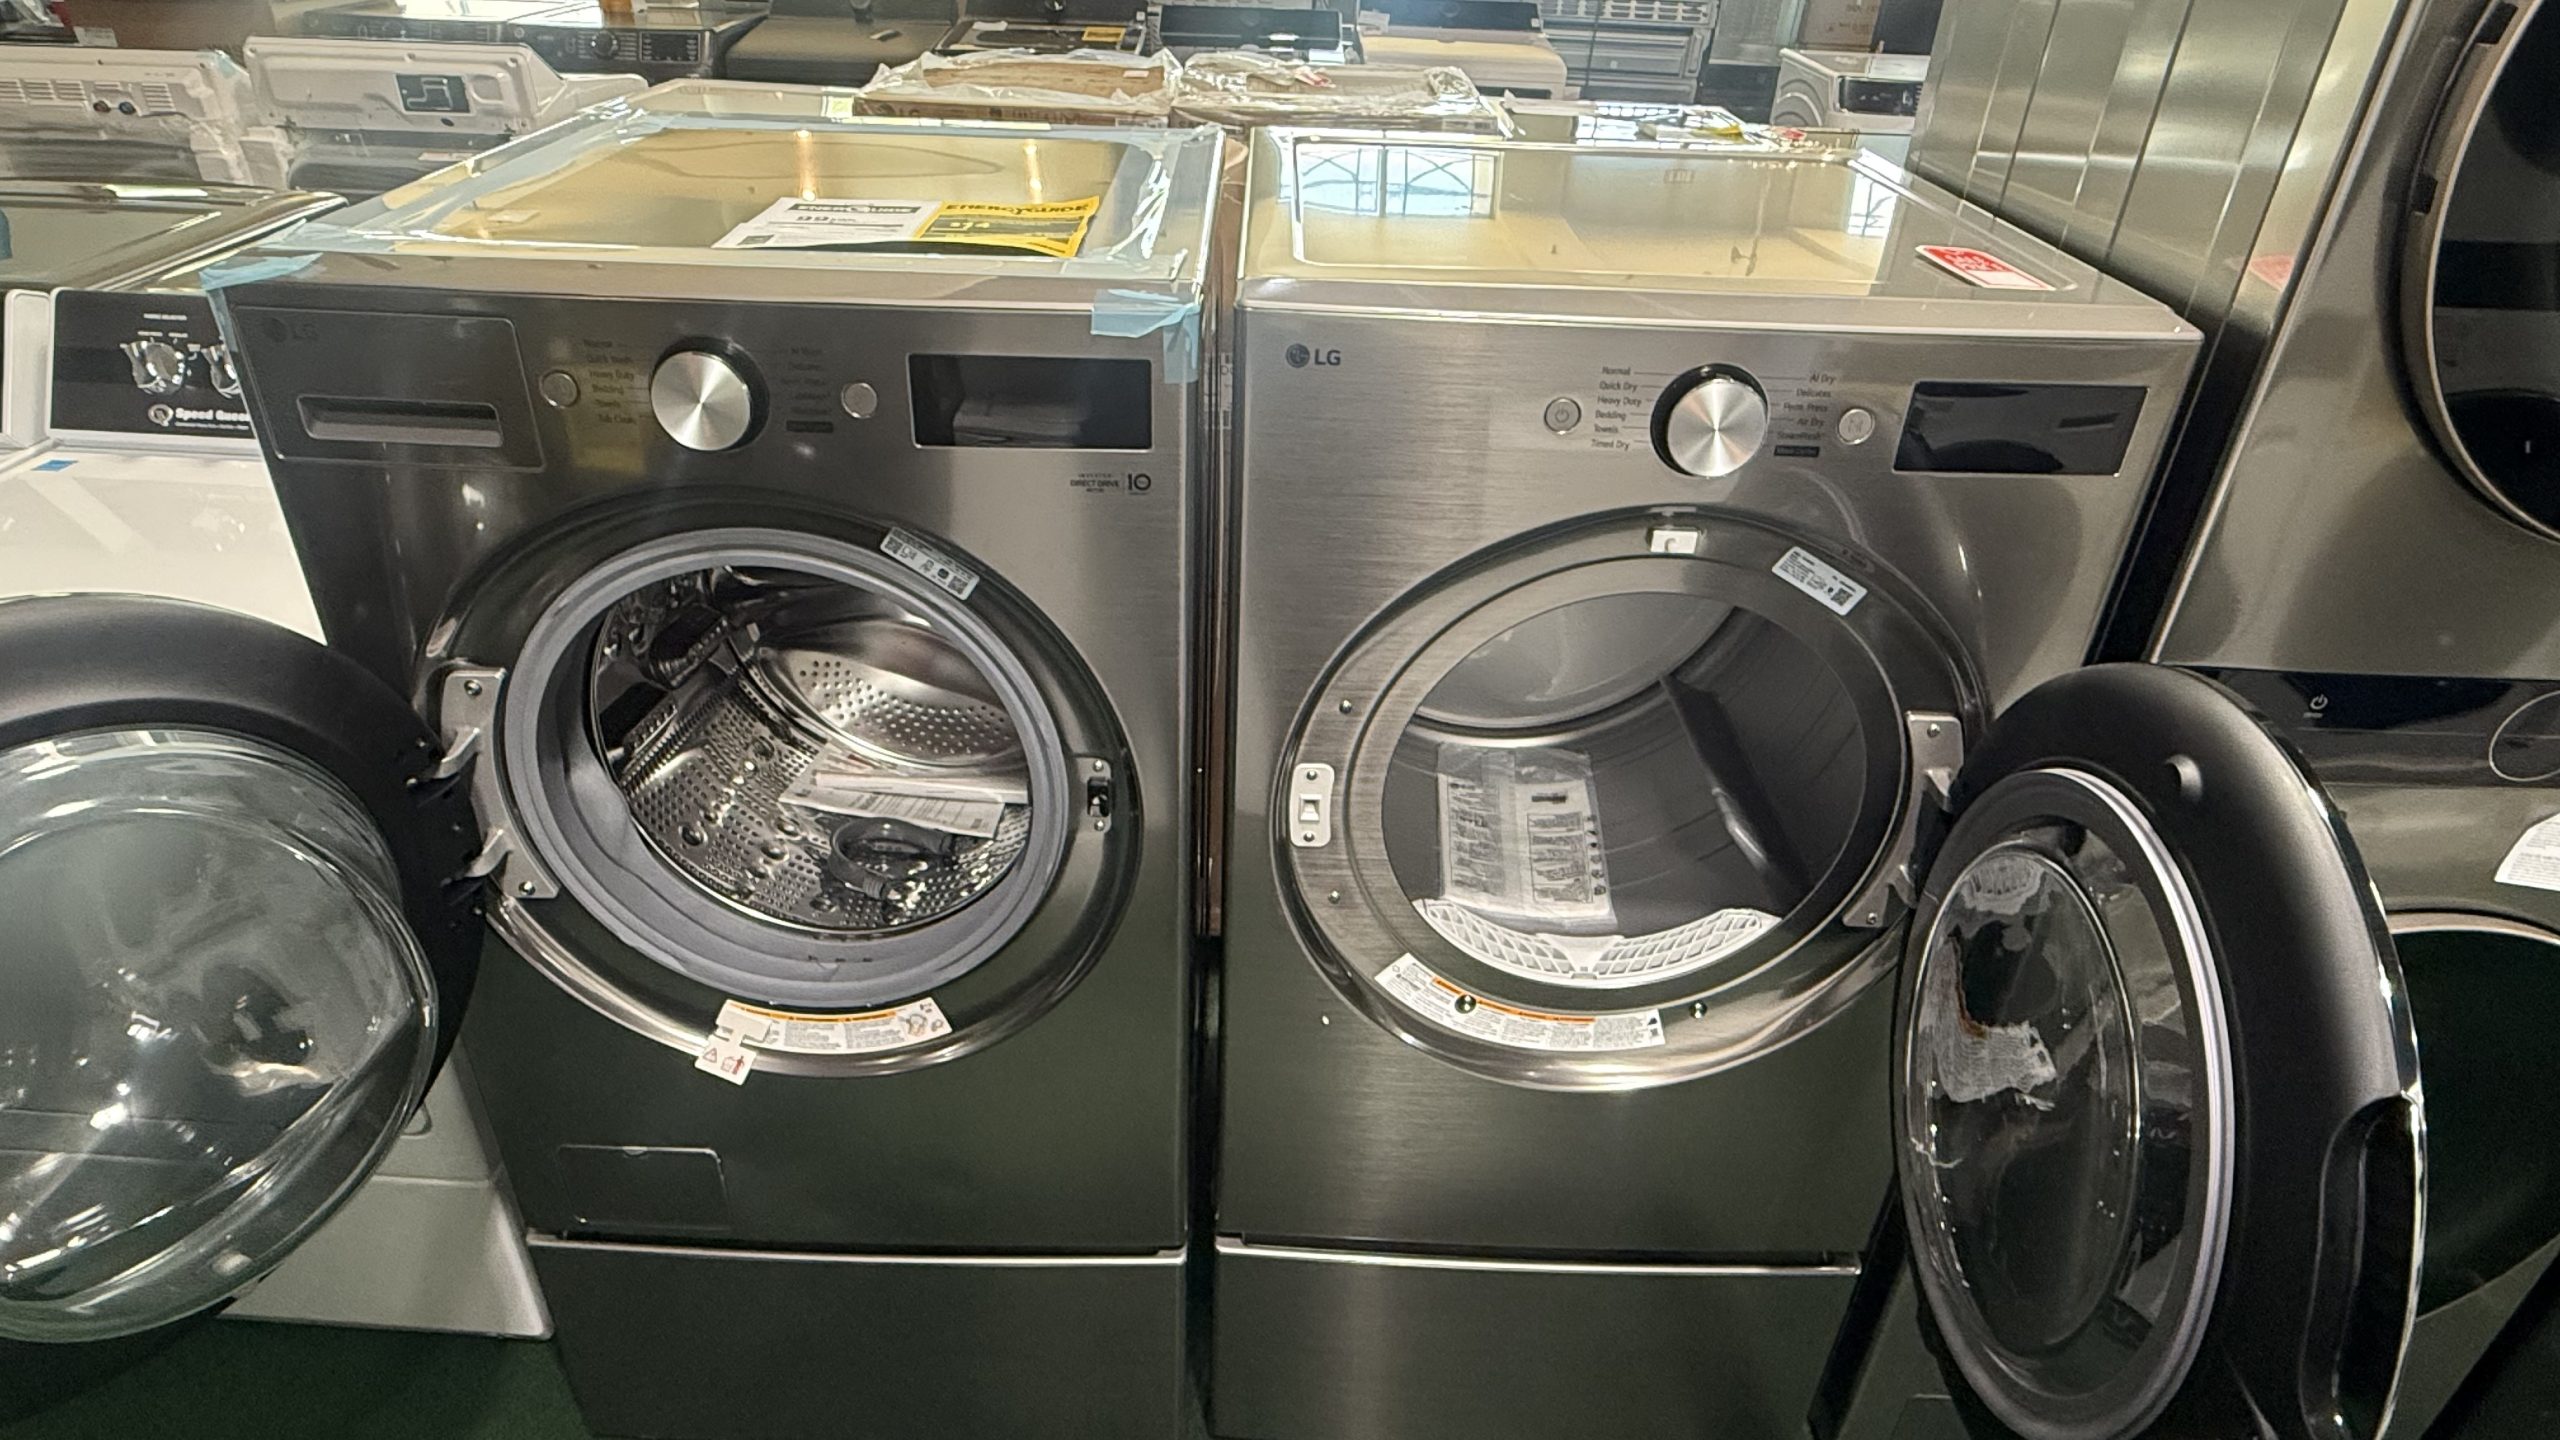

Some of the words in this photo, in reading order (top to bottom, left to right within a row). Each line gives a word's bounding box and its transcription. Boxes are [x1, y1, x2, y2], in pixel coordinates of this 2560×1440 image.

[1314, 348, 1341, 366] LG
[1600, 381, 1620, 390] Quick
[1623, 381, 1638, 393] Dry
[1597, 396, 1620, 406] Heavy
[1623, 397, 1642, 408] Duty
[175, 407, 214, 421] Speed
[1595, 410, 1626, 421] Bedding
